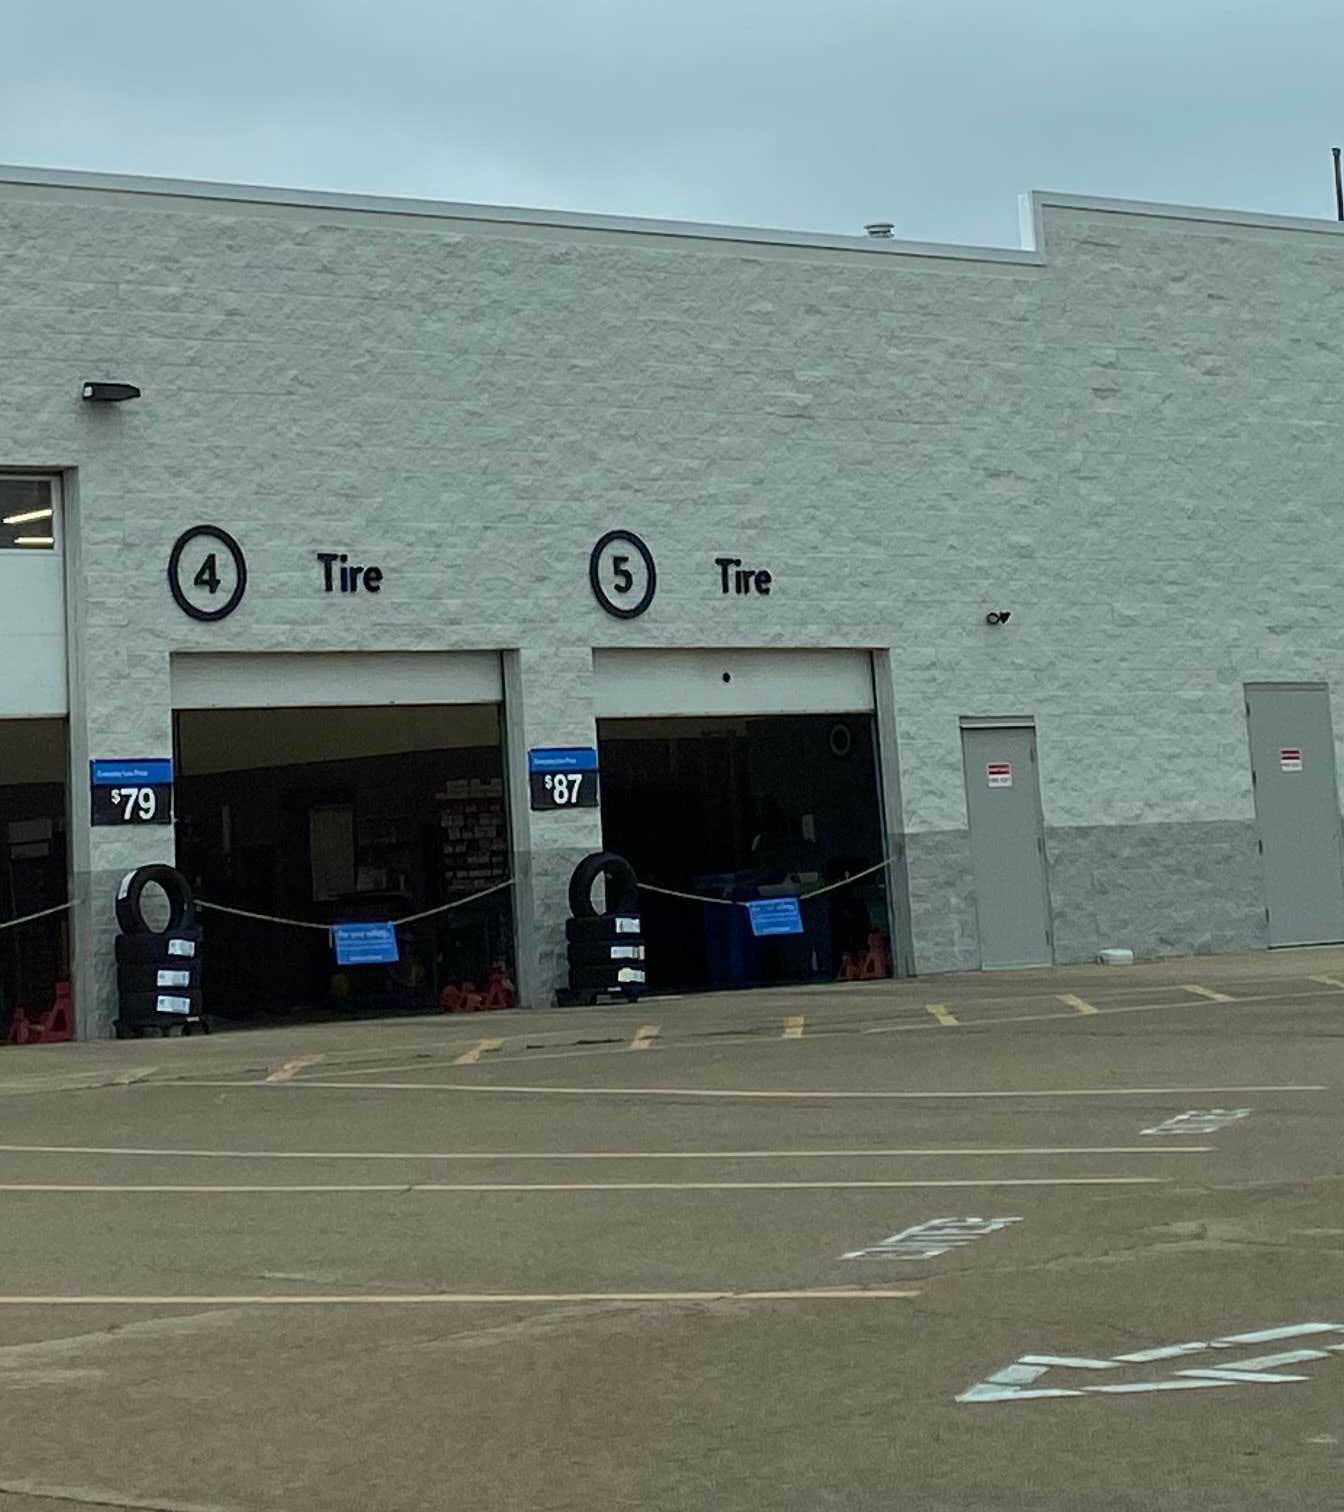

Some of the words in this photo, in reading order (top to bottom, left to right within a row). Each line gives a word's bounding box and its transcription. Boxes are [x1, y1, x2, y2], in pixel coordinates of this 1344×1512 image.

[192, 553, 221, 595] 4
[316, 552, 384, 594] Tire
[612, 555, 634, 594] 5
[714, 557, 773, 596] Tire
